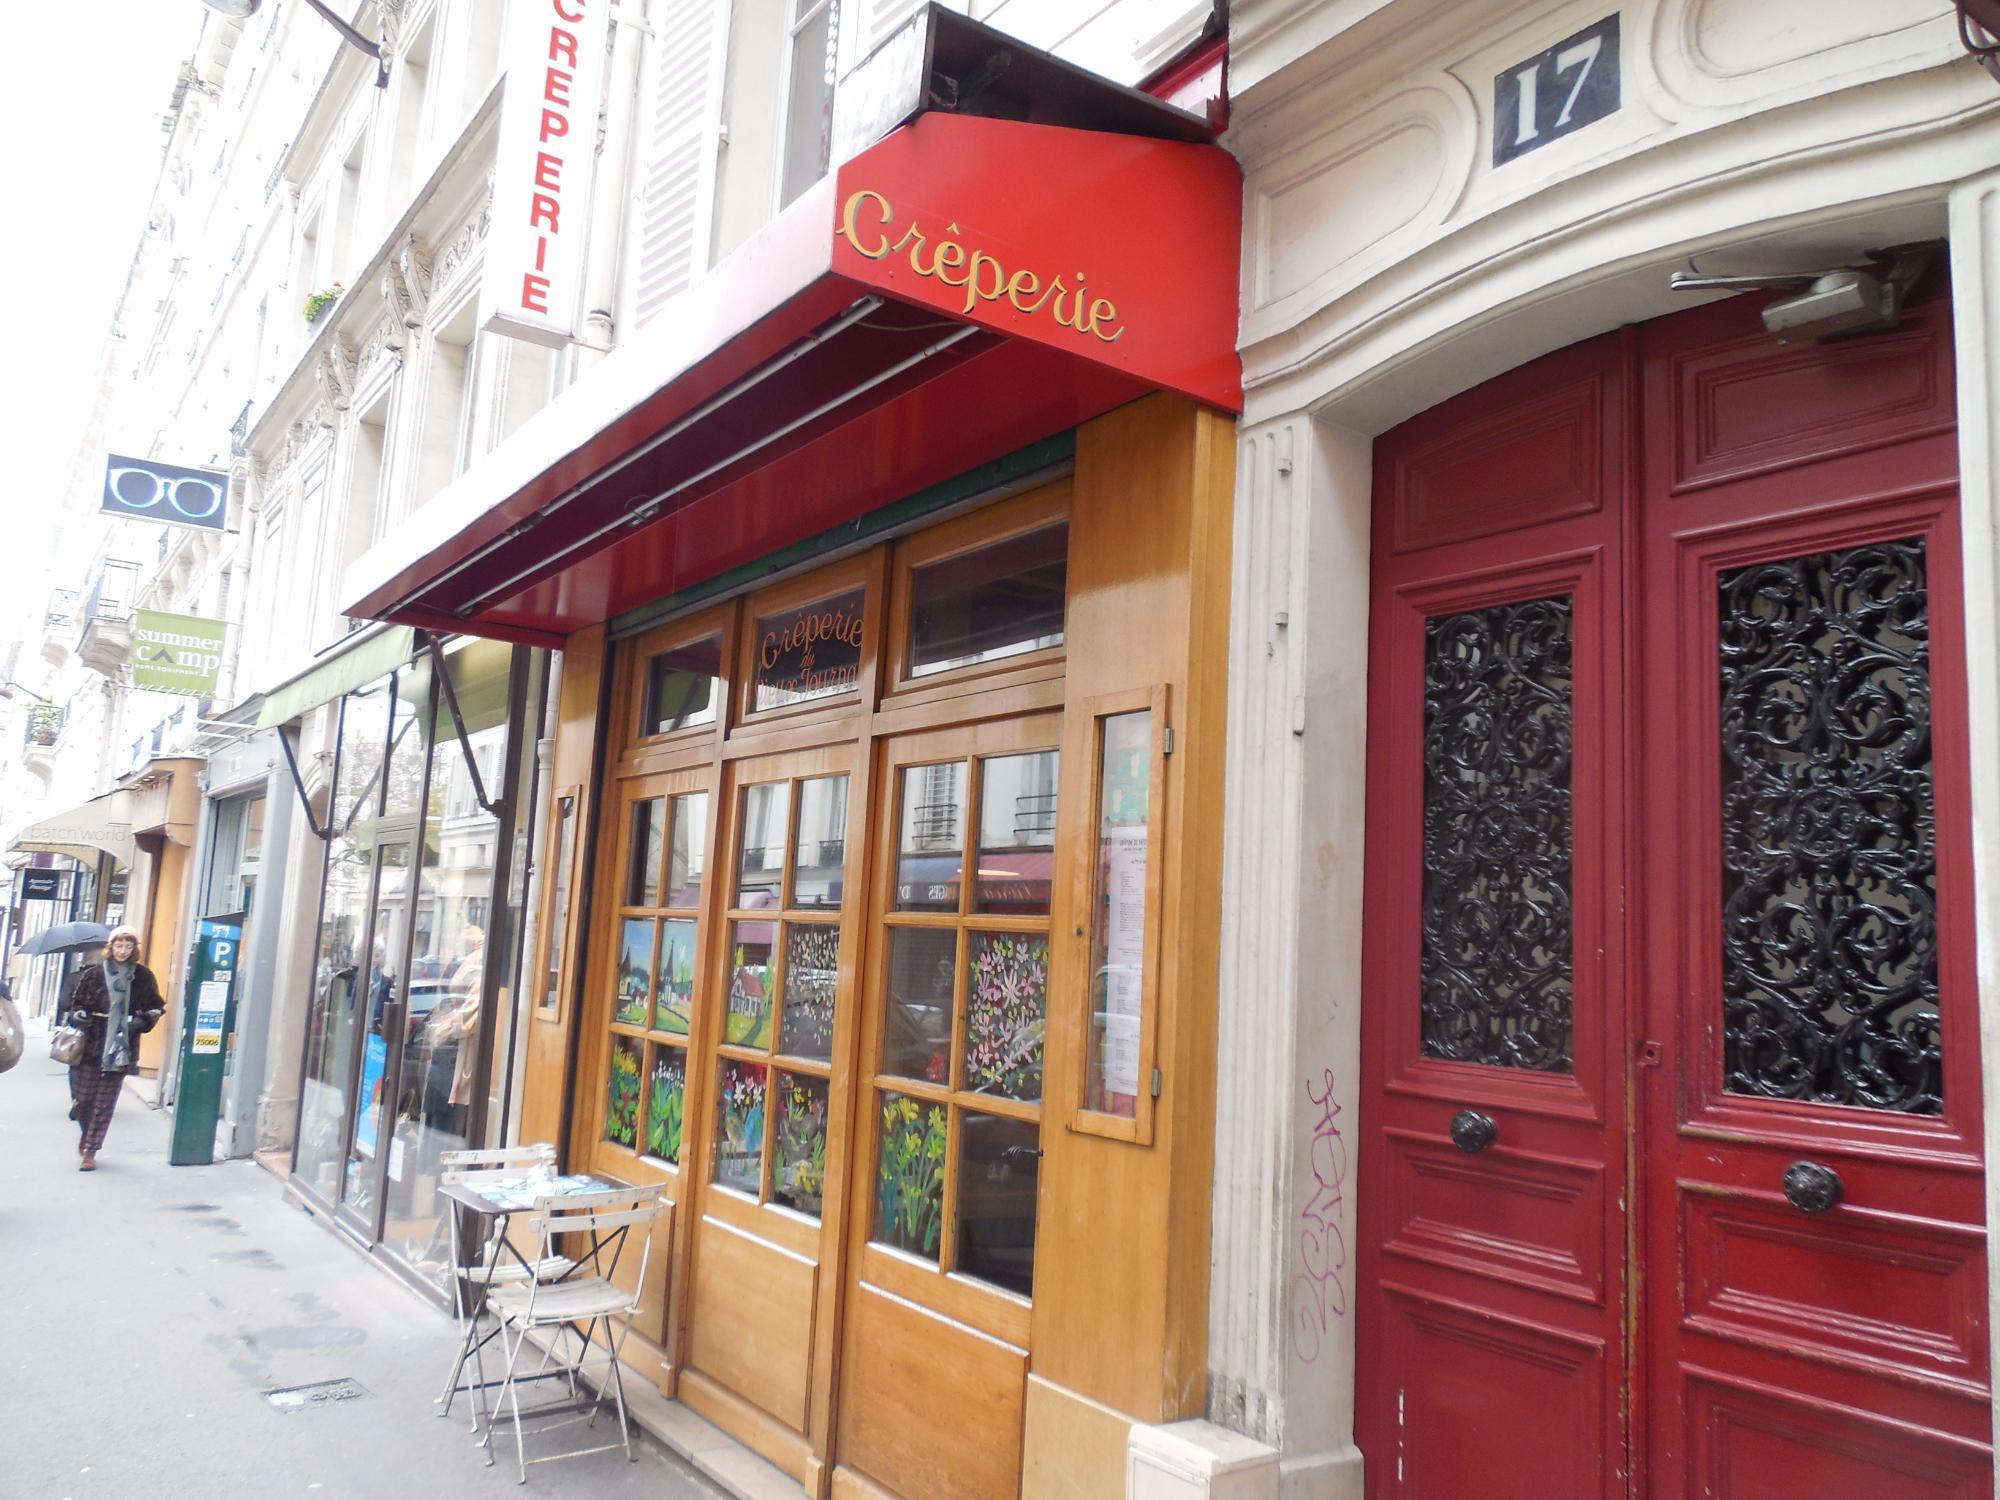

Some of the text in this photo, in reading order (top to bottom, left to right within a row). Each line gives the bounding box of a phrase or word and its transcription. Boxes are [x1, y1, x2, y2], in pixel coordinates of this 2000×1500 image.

[1514, 34, 1602, 146] 17
[521, 0, 586, 315] CREPERIE
[835, 190, 1125, 343] Crêperie
[137, 628, 223, 652] summer
[213, 941, 232, 963] P
[195, 1038, 219, 1047] 75006
